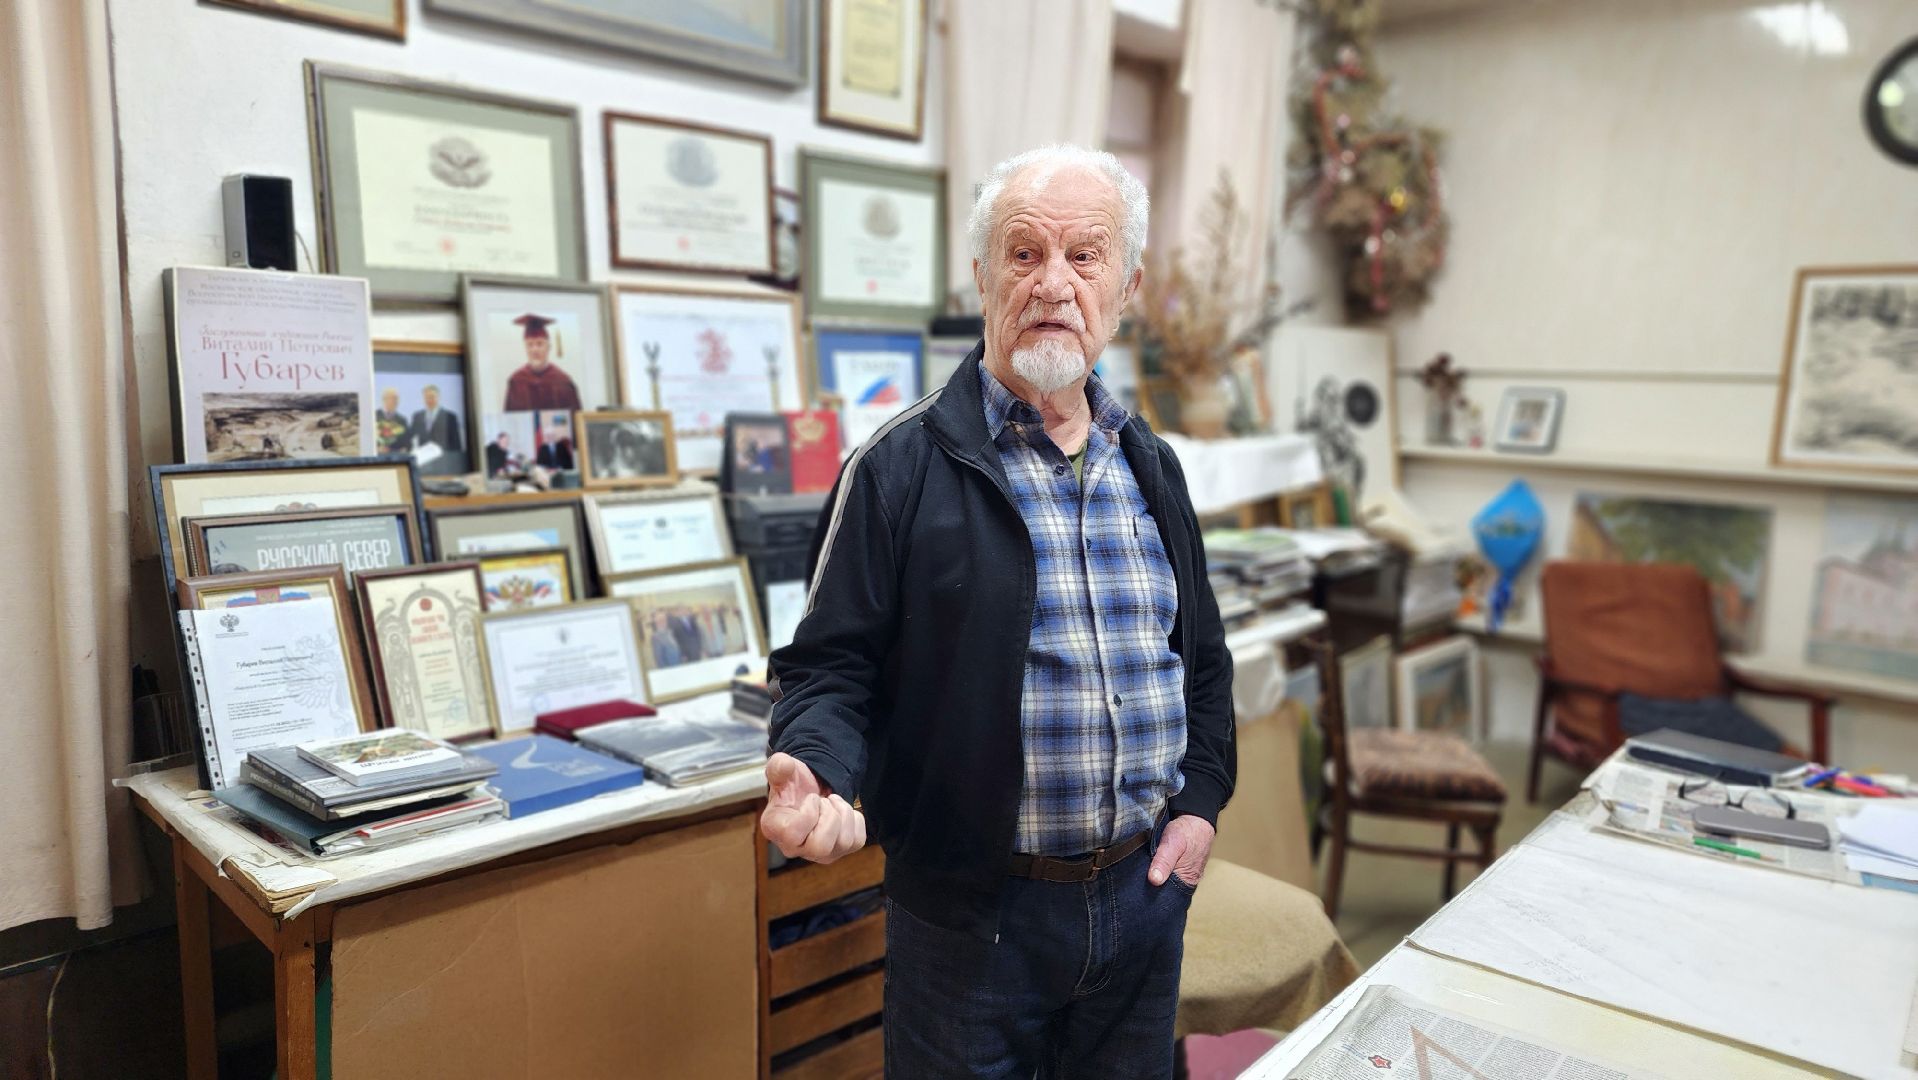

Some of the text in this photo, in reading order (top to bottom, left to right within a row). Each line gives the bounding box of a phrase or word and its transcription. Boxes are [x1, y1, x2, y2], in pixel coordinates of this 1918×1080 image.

[221, 351, 345, 390] Губарев
[257, 538, 391, 572] РУССКИЙ СЕВЕР
